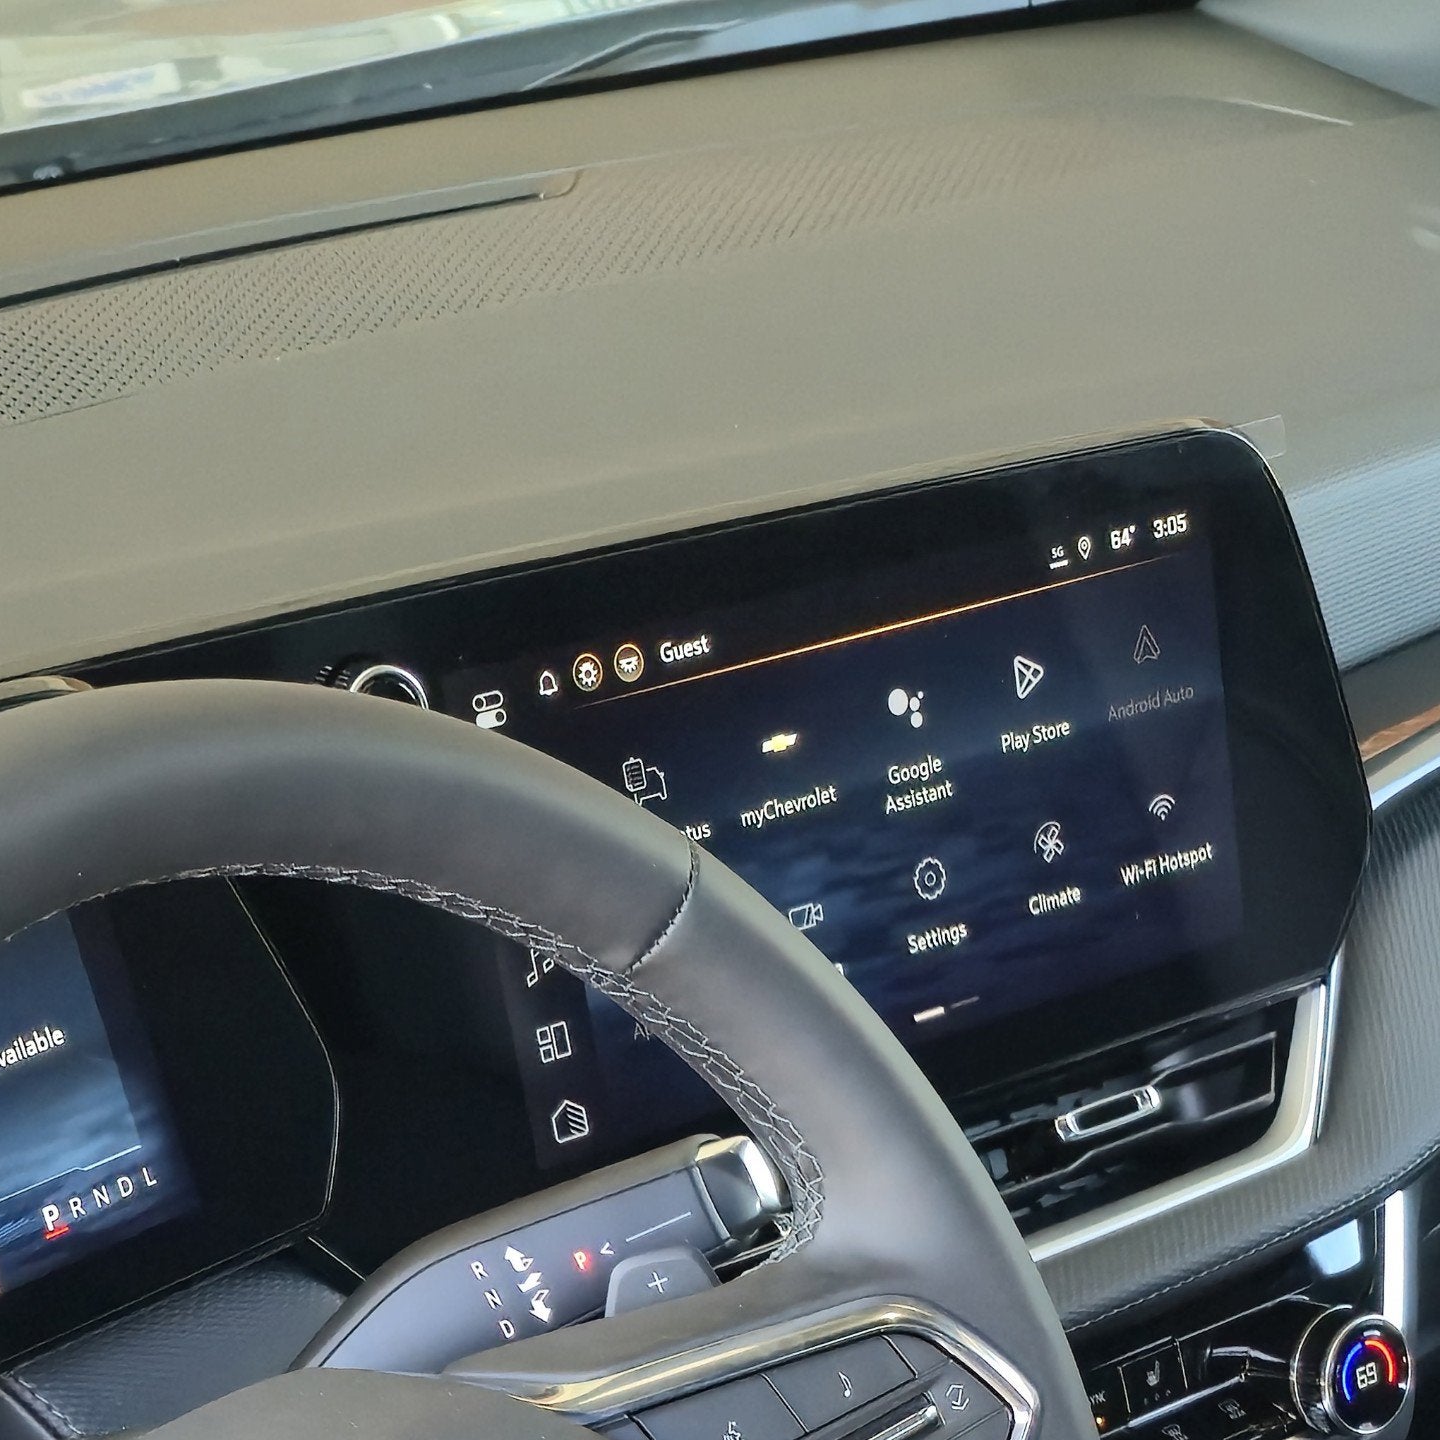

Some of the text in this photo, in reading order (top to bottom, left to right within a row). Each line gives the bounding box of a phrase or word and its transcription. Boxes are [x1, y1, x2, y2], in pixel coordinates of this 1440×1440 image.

[1153, 513, 1188, 539] 3:05
[660, 635, 710, 664] Guest
[1108, 685, 1194, 722] Android Auto
[1001, 720, 1071, 754] Play Store
[887, 756, 943, 788] Google
[740, 785, 838, 829] myChevrolet
[884, 780, 954, 815] Assistant
[1121, 843, 1213, 887] Wi-Fi Hotspot
[1029, 886, 1081, 916] Climate
[907, 922, 969, 955] Settings
[42, 1167, 157, 1231] P R N D L
[471, 1261, 489, 1280] R
[574, 1251, 587, 1270] P
[484, 1289, 503, 1309] N
[499, 1319, 514, 1339] D
